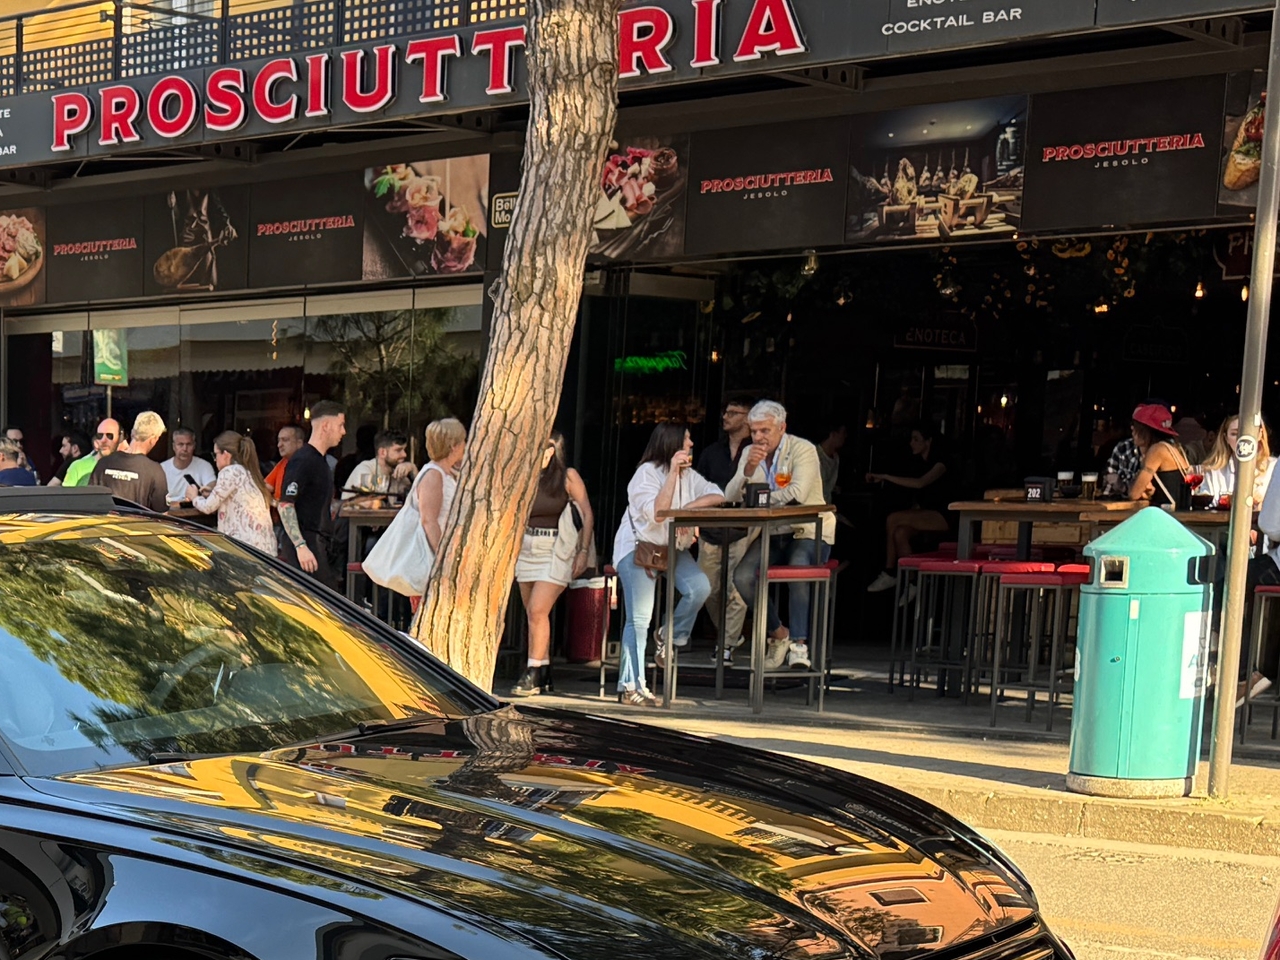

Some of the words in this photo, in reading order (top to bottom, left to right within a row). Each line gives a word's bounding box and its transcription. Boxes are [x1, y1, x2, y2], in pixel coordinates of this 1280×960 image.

[881, 14, 974, 36] COCKTAIL
[982, 8, 1022, 24] BAR
[51, 0, 807, 152] PROSCIUTTRIA
[1042, 133, 1205, 162] PROSCIUTTERIA
[1094, 157, 1149, 168] JESOLO
[700, 168, 834, 194] PROSCIUTTERIA
[495, 197, 516, 211] Bell
[743, 190, 788, 200] JESOLO
[257, 214, 355, 236] PROSCIUTTERIA
[53, 237, 137, 256] PROSCIUTTERIA
[288, 233, 322, 241] JESOLO
[1027, 488, 1041, 498] 202
